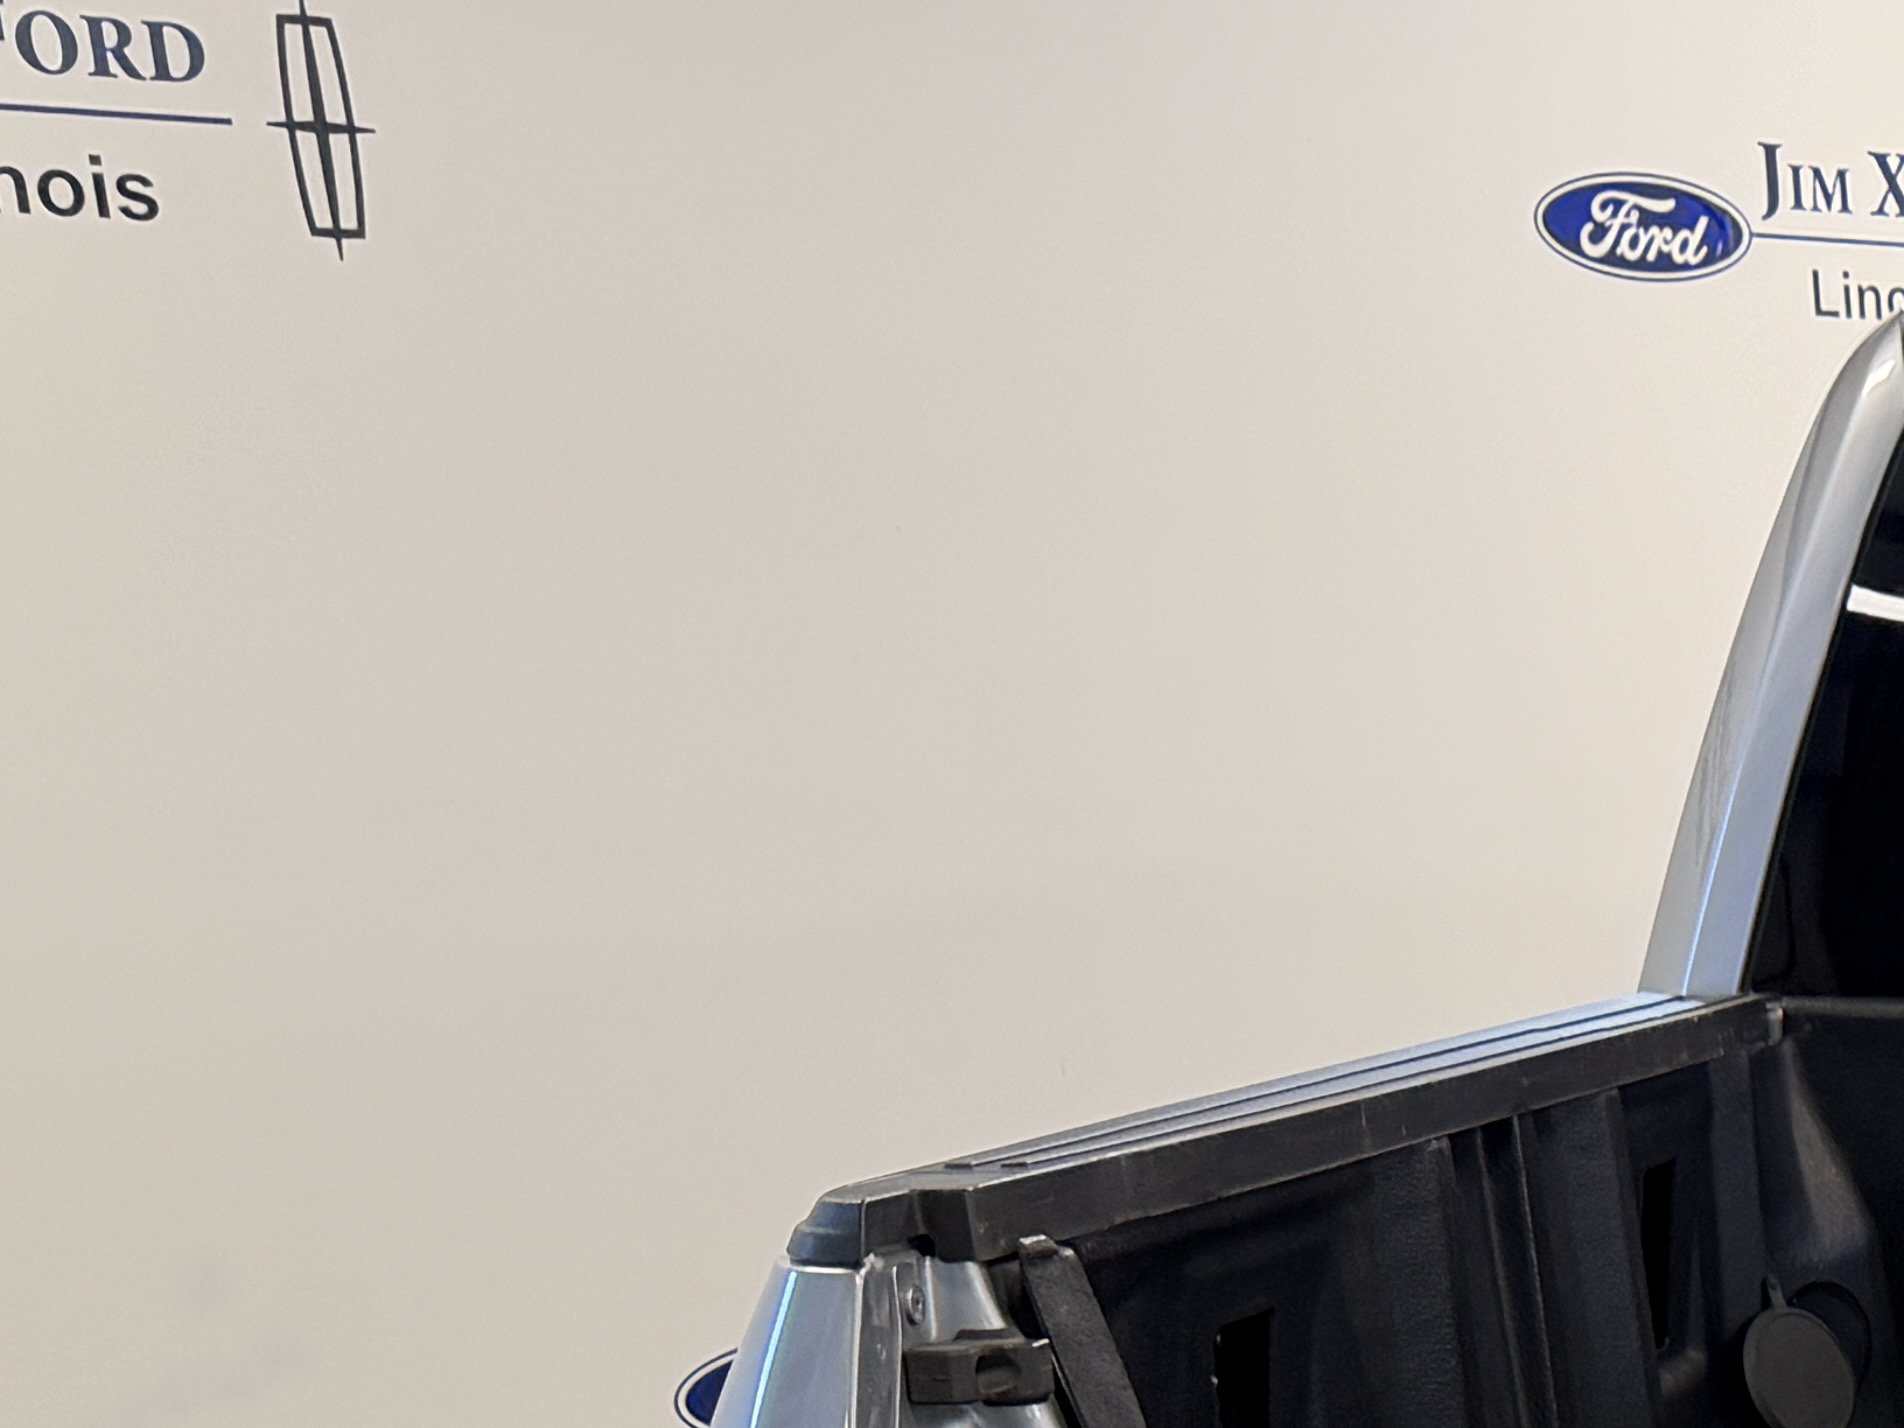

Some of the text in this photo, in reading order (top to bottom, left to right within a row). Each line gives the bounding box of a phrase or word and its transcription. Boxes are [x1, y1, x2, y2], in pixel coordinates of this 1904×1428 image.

[0, 4, 206, 83] ORD
[1757, 141, 1854, 221] JIM
[1579, 189, 1711, 266] Ford
